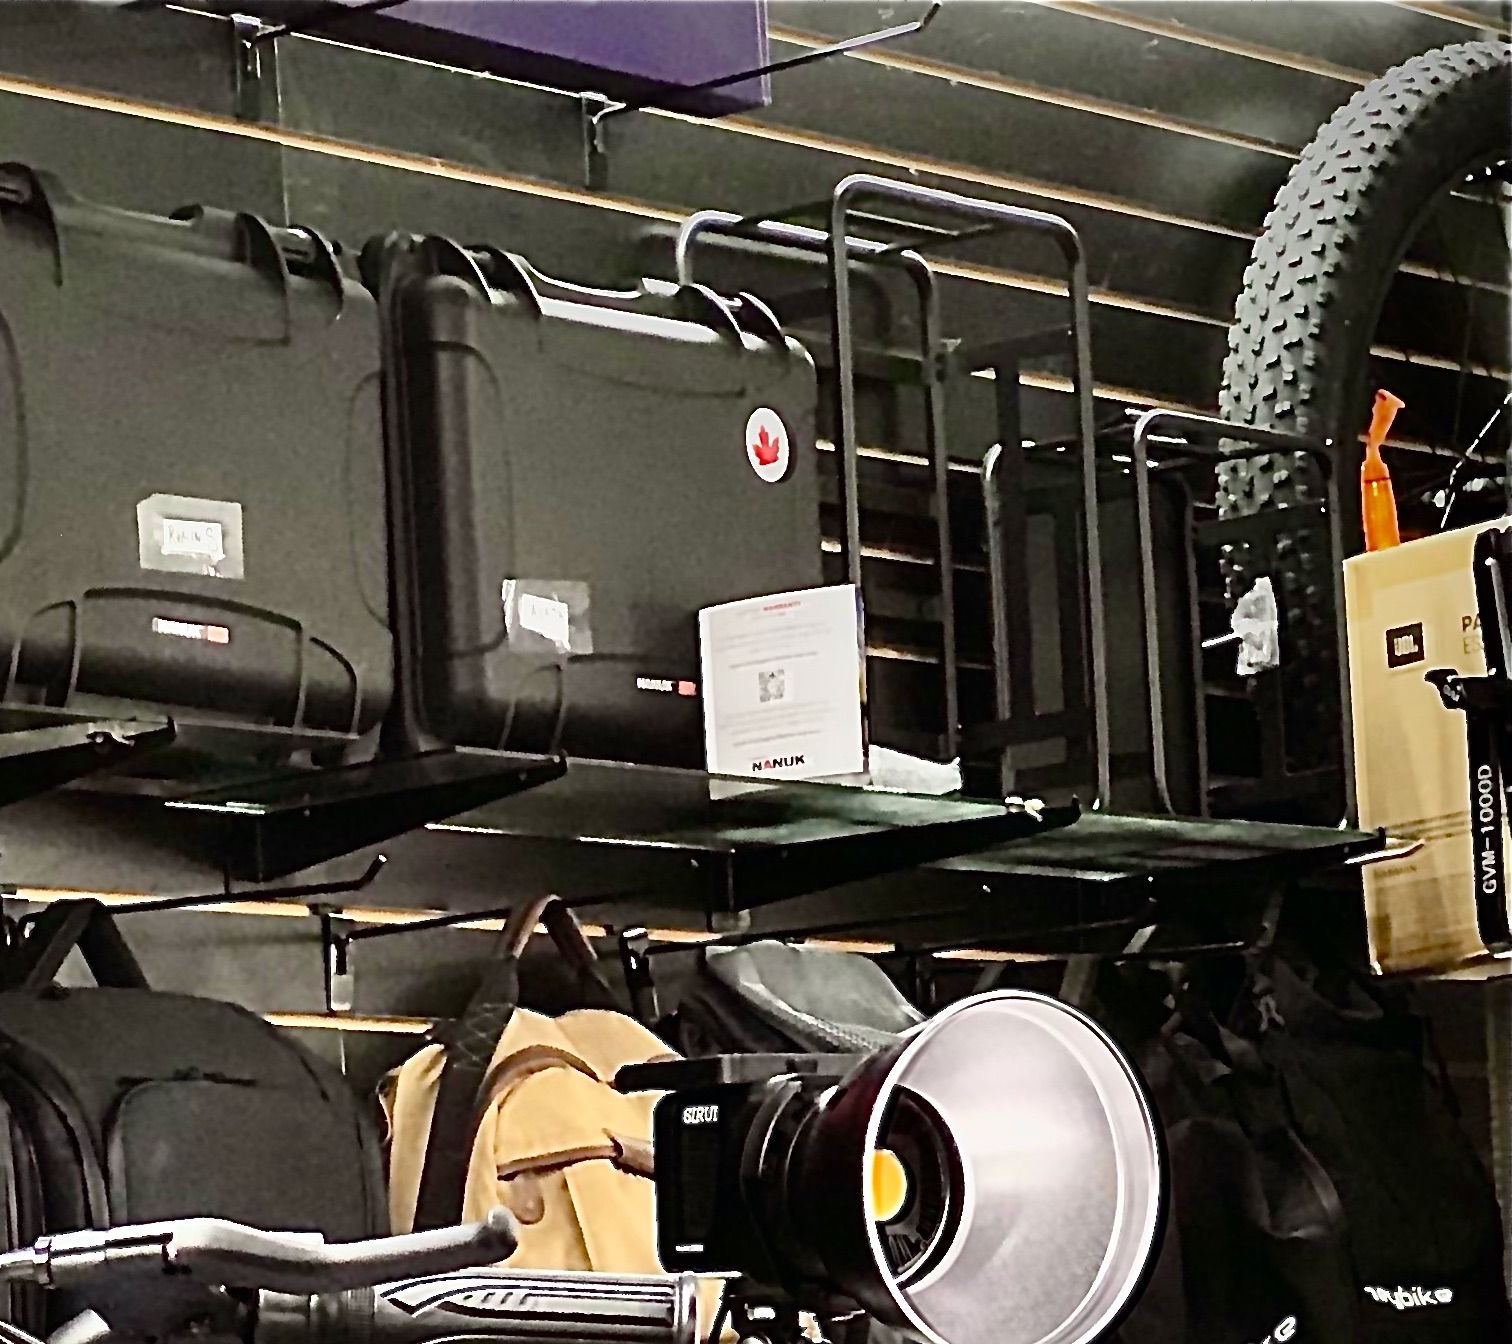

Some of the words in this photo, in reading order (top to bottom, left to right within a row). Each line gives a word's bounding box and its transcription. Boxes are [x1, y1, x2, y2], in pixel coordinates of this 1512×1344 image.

[752, 754, 805, 772] NANUK
[1478, 764, 1497, 894] GVM-1000D
[682, 1105, 719, 1125] SIRUI
